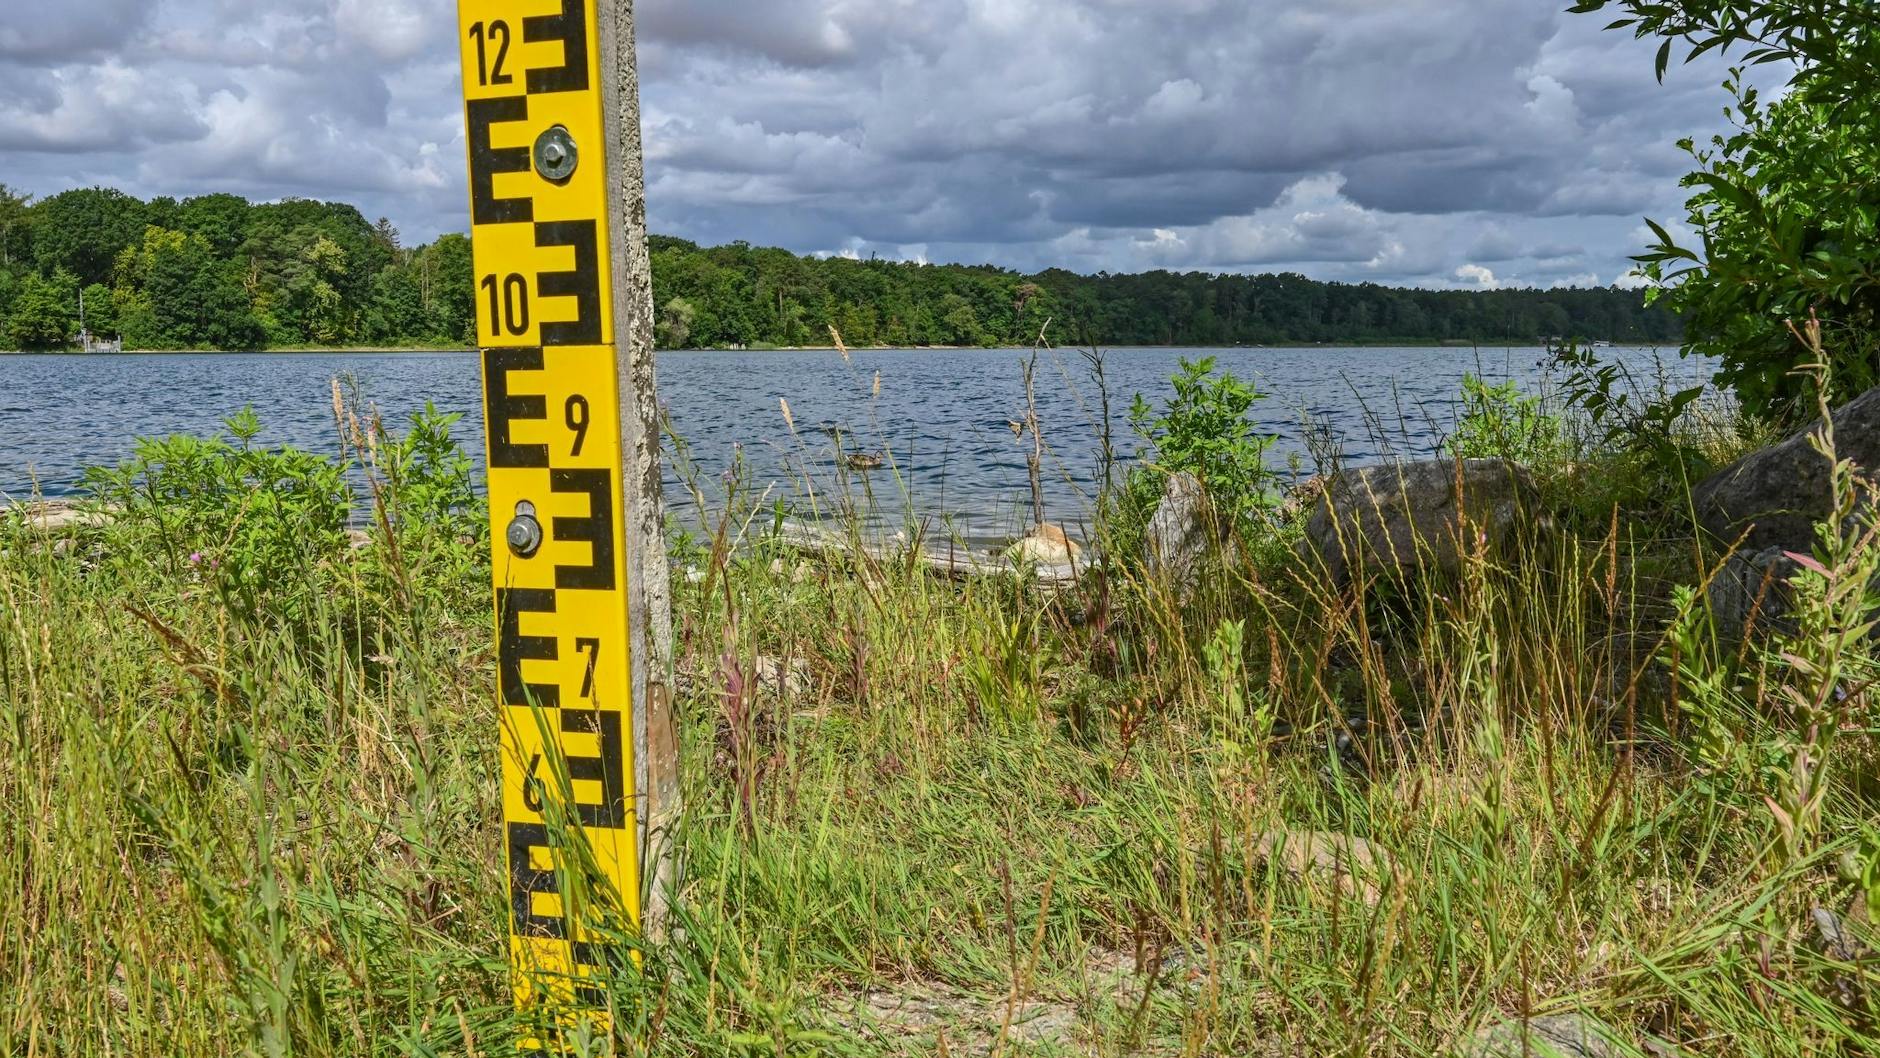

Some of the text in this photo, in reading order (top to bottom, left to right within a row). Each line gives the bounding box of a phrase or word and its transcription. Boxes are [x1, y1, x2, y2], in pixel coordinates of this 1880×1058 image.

[469, 20, 512, 86] 12
[481, 272, 529, 336] 10
[565, 394, 589, 456] 9
[576, 637, 599, 697] 7
[523, 754, 546, 812] 6
